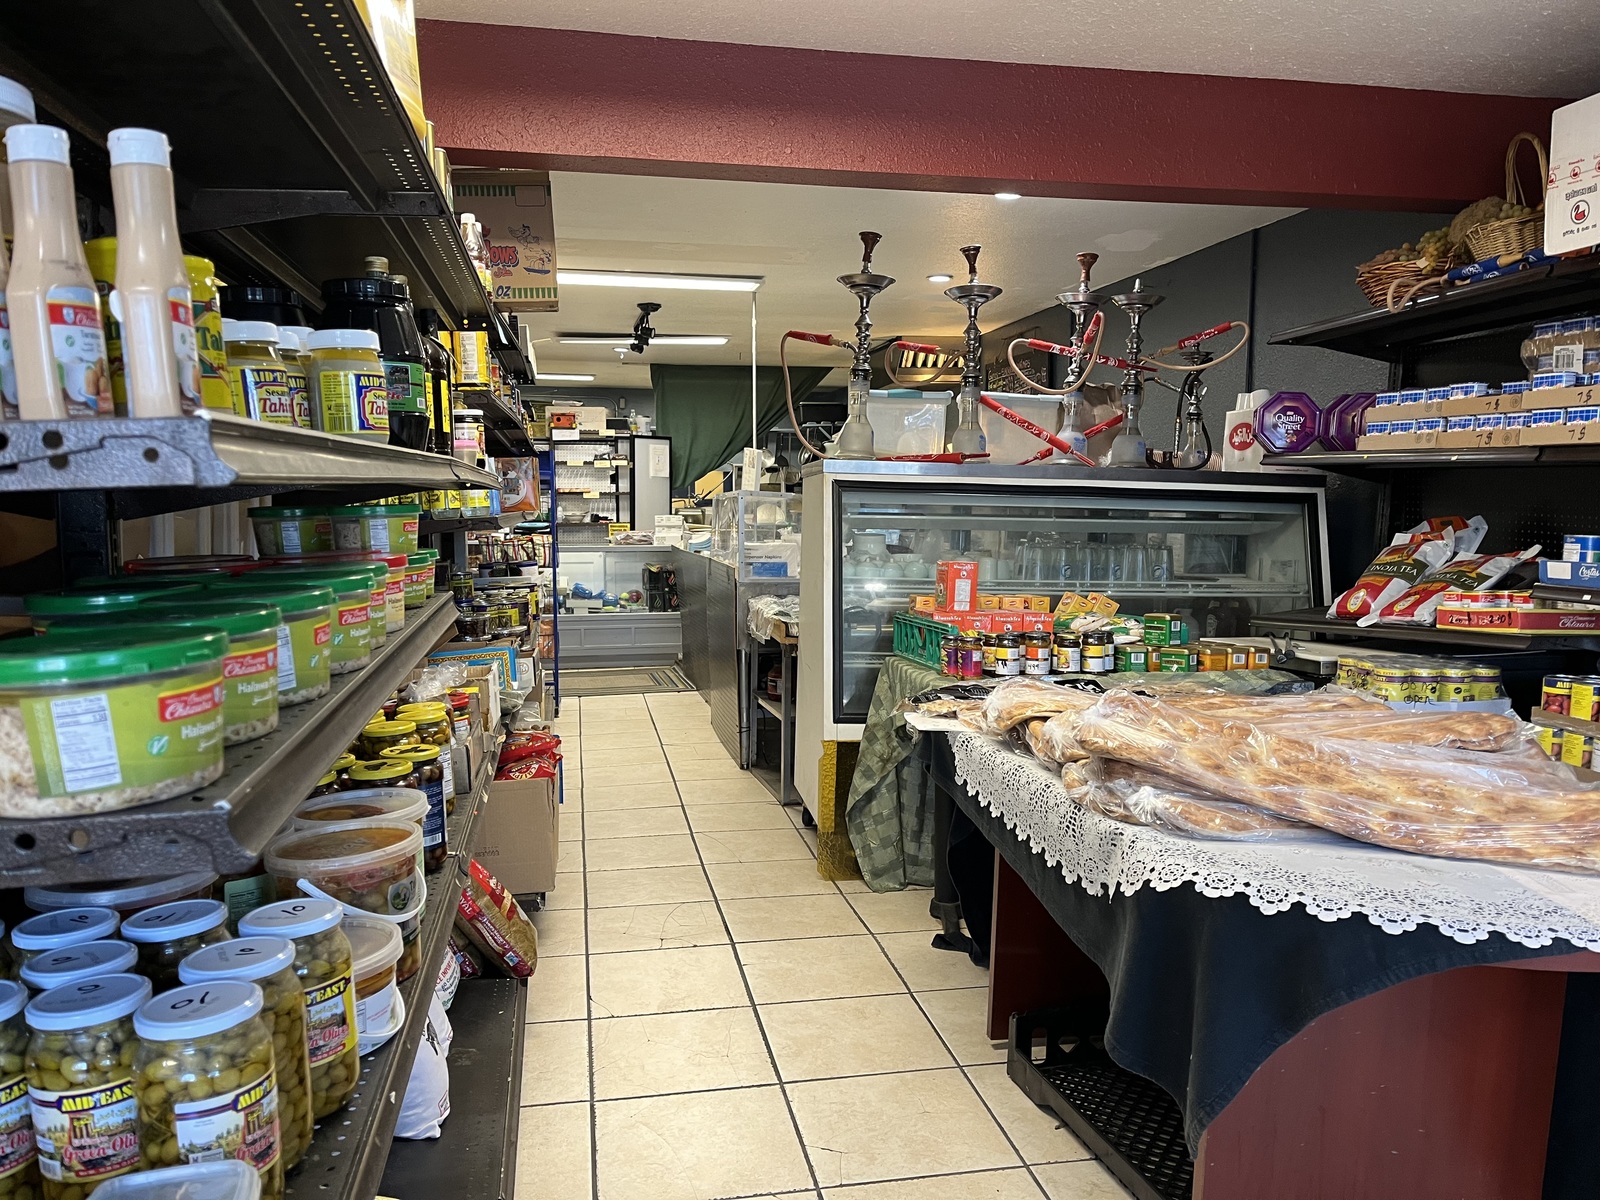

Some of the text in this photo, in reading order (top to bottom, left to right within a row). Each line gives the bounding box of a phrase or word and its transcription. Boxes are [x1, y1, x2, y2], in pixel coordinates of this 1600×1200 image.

[496, 285, 511, 297] OZ
[196, 326, 223, 351] Tah
[1275, 413, 1305, 424] Quality
[1278, 421, 1301, 431] Street
[1370, 564, 1417, 576] INDIA TEA
[1559, 618, 1595, 628] Chtaura
[316, 980, 345, 1003] EAST
[62, 1095, 95, 1112] MID
[63, 1144, 107, 1165] Green
